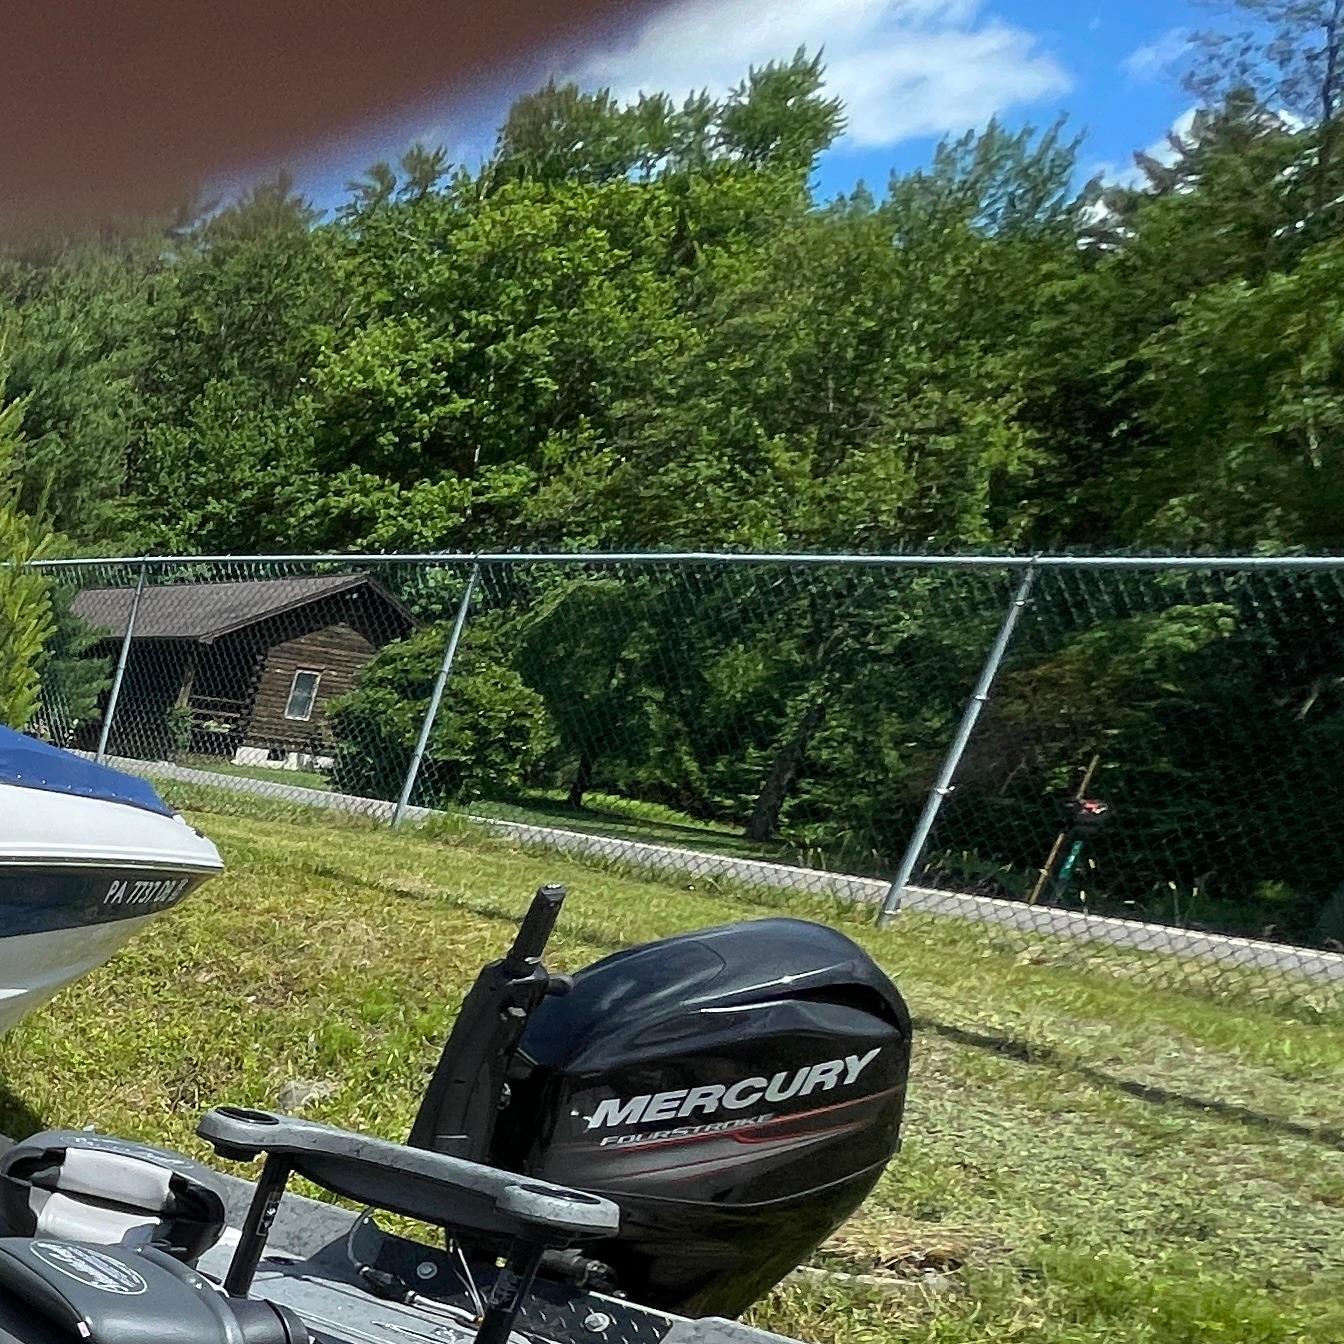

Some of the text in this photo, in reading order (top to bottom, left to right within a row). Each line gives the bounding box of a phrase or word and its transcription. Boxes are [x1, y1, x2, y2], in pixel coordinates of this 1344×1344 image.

[102, 879, 129, 904] PA
[584, 1046, 883, 1131] MERCURY
[599, 1112, 776, 1148] FOURSTROKE
